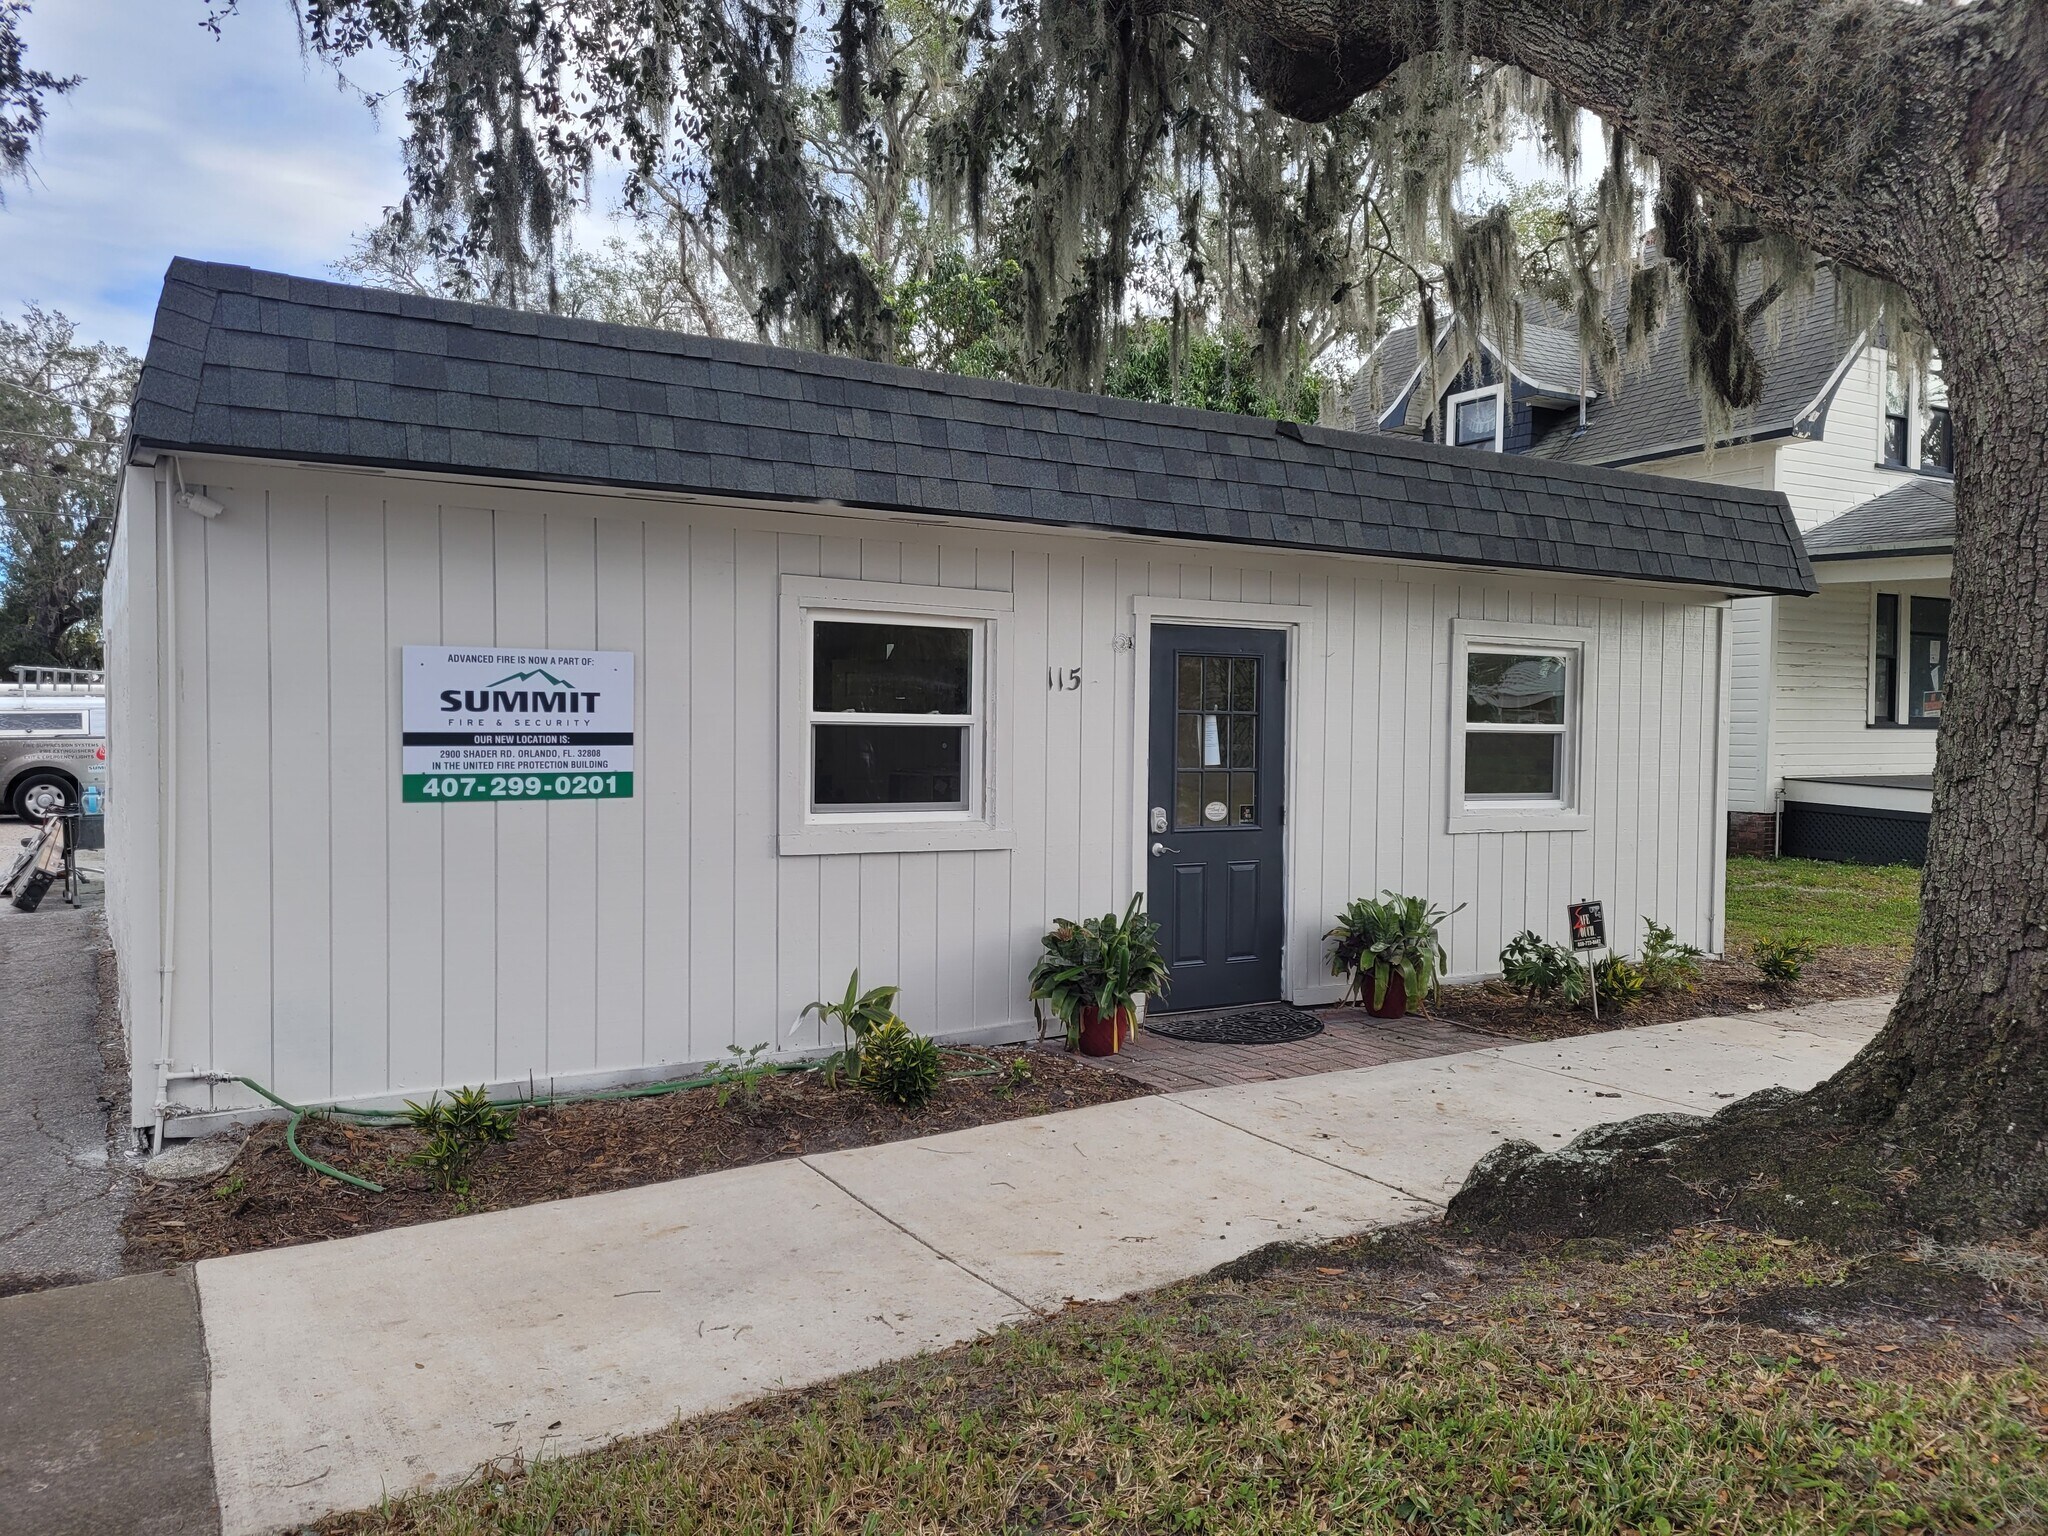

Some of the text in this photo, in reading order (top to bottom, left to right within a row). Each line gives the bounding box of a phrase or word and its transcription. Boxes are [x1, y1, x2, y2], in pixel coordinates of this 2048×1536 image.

[447, 654, 595, 666] ADVANCED FIRE IS NOW A PART OF:
[1048, 666, 1081, 691] 115
[440, 689, 601, 713] SUMMIT
[448, 719, 591, 727] FIRE & SECURITY
[473, 735, 570, 744] OUR NEW LOCATION IS:
[440, 749, 601, 759] 2900 SHADER RD. ORLANDO, FL. 32808
[432, 760, 608, 770] IN THE UNITED FIRE PROTECTION BUILDING
[422, 776, 617, 797] 407-299-0201
